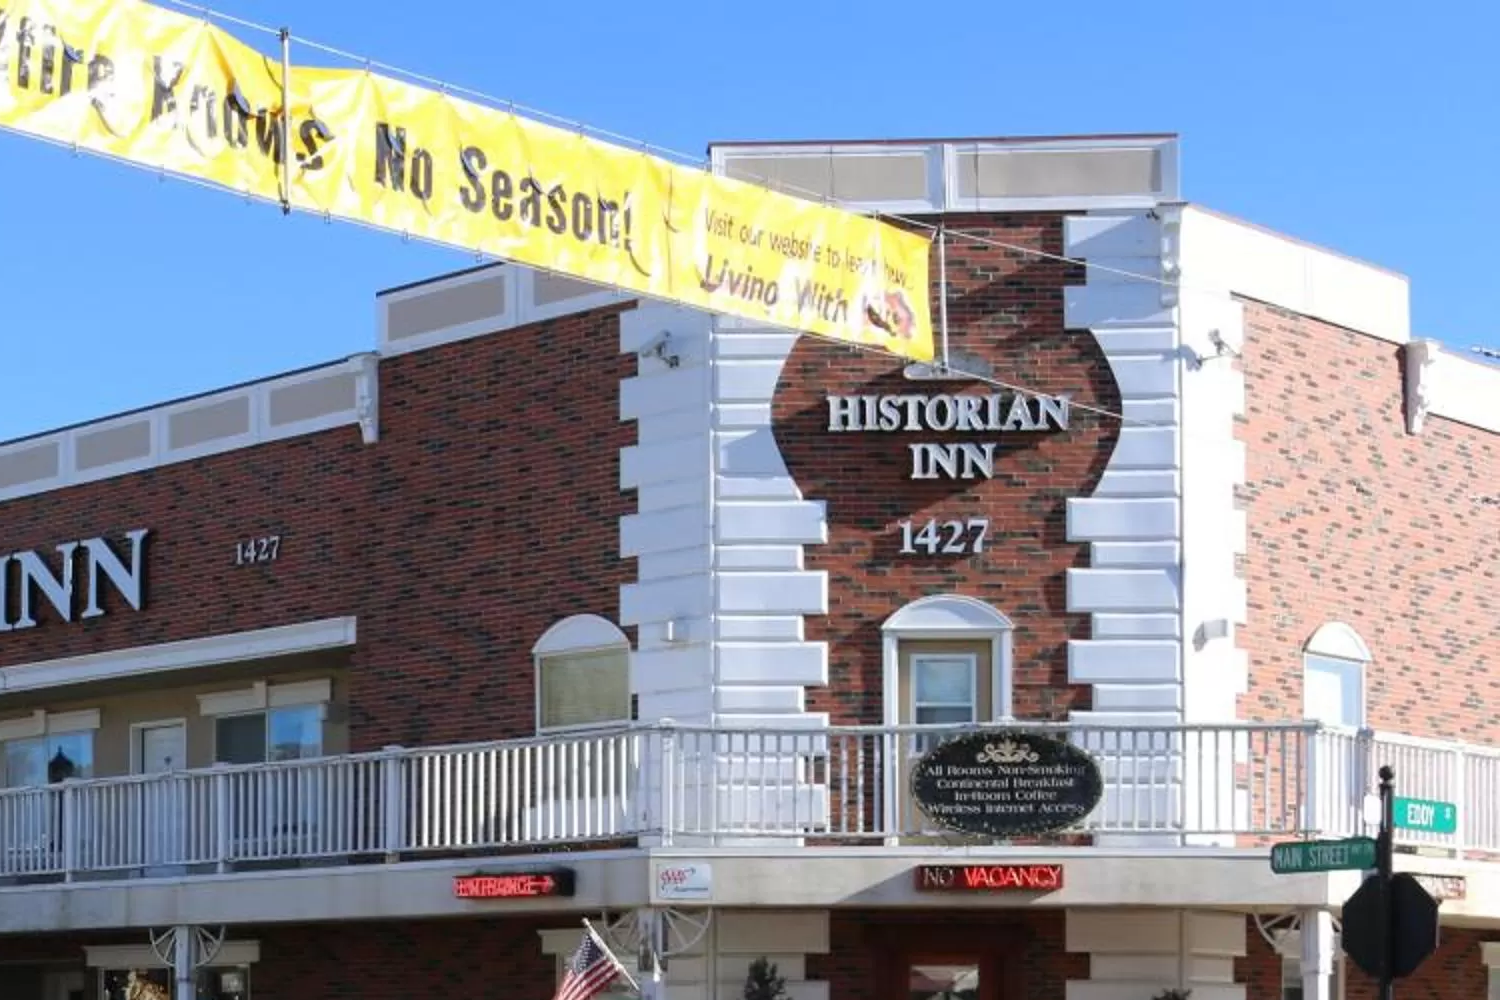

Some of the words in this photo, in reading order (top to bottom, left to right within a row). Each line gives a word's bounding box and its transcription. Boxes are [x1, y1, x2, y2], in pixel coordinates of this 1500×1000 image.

[374, 121, 433, 200] No
[459, 146, 633, 250] Season!
[705, 207, 733, 239] Visit
[739, 224, 764, 249] our
[827, 245, 841, 267] to
[794, 274, 849, 323] With
[826, 393, 1074, 432] HISTORIAN
[908, 442, 997, 479] INN
[898, 517, 989, 554] 1427
[236, 535, 279, 565] 1427
[926, 765, 942, 776] All
[947, 765, 993, 776] Rooms
[936, 778, 1009, 789] Continental
[1013, 777, 1074, 788] Breakfast
[928, 802, 982, 813] Wireless
[985, 802, 1034, 813] Internet
[1037, 802, 1086, 813] Access
[954, 790, 1011, 801] In-Room
[1015, 790, 1058, 800] Coffee
[1407, 803, 1435, 828] EDDY
[1274, 847, 1303, 869] MAIN
[1308, 844, 1349, 867] STREET
[923, 867, 954, 886] NO
[963, 866, 1061, 888] VACANCY
